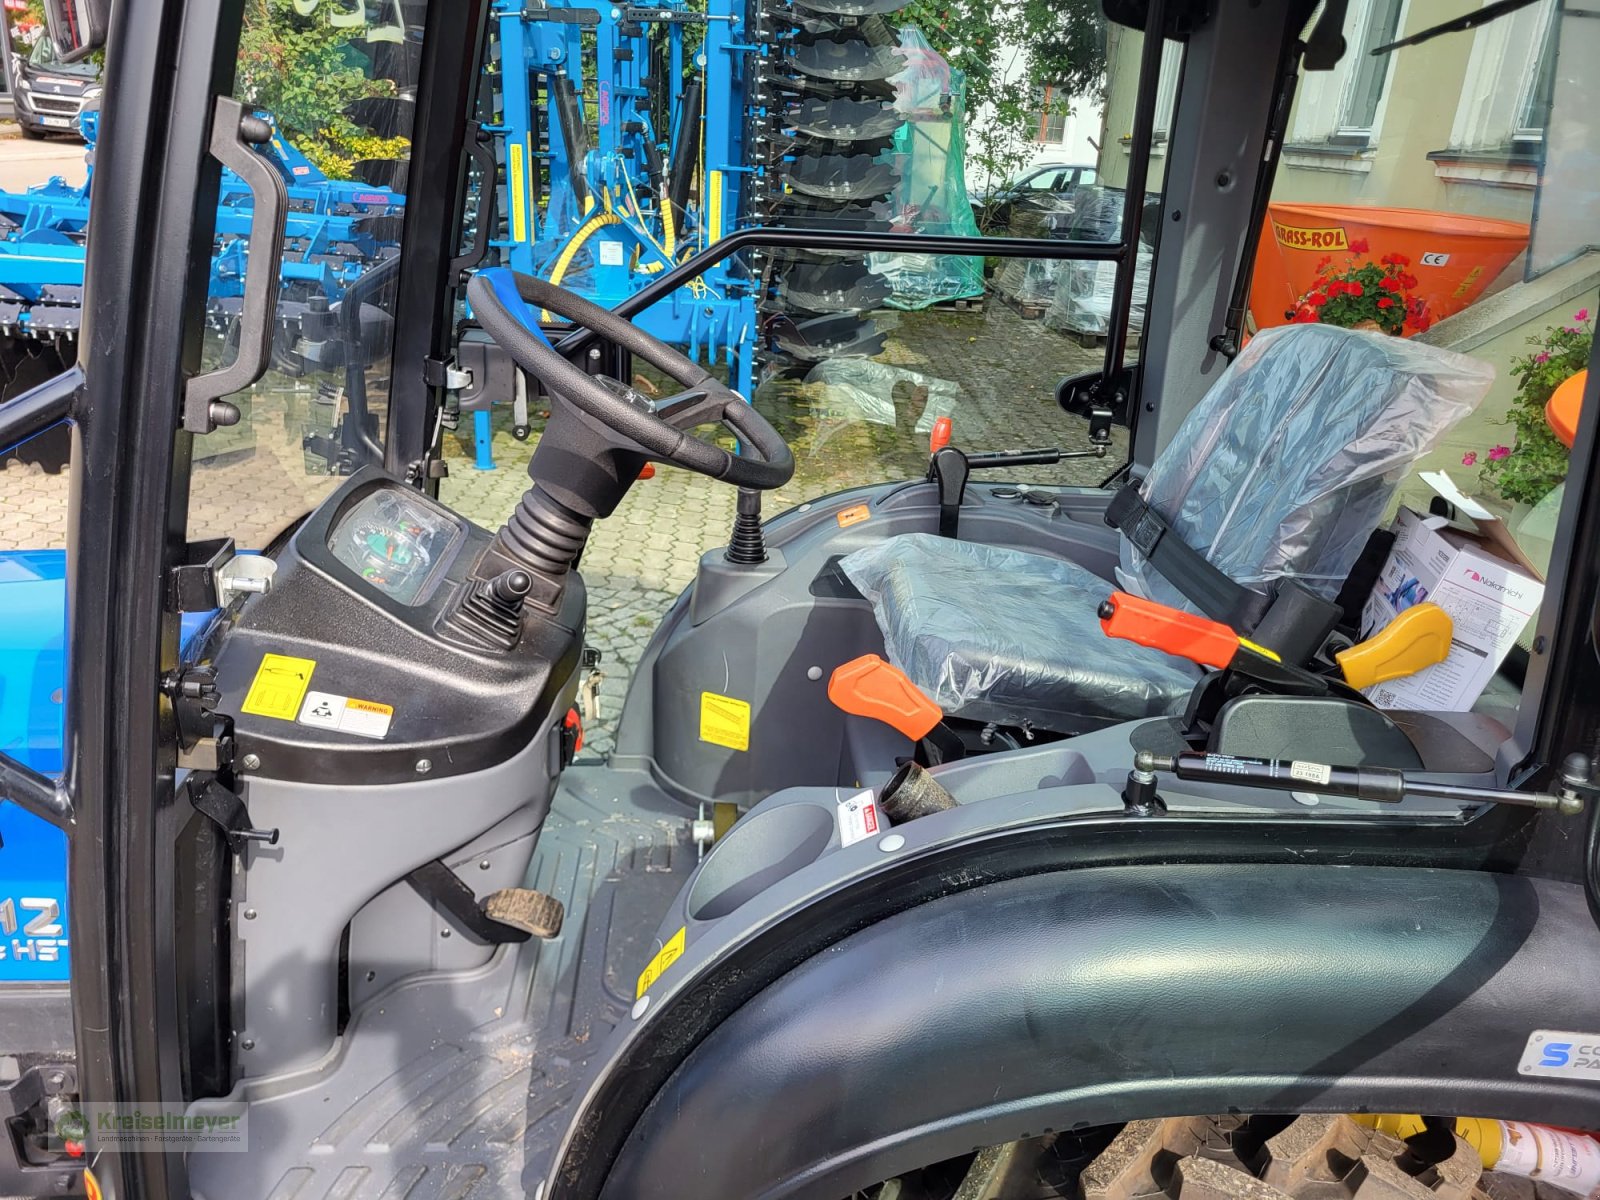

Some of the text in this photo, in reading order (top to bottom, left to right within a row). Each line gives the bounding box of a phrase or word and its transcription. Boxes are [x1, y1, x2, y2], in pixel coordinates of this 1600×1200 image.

[1275, 225, 1344, 248] GRASS-ROL
[1424, 254, 1444, 265] CE
[1480, 575, 1524, 600] Nakamichi
[358, 704, 388, 713] WARNING
